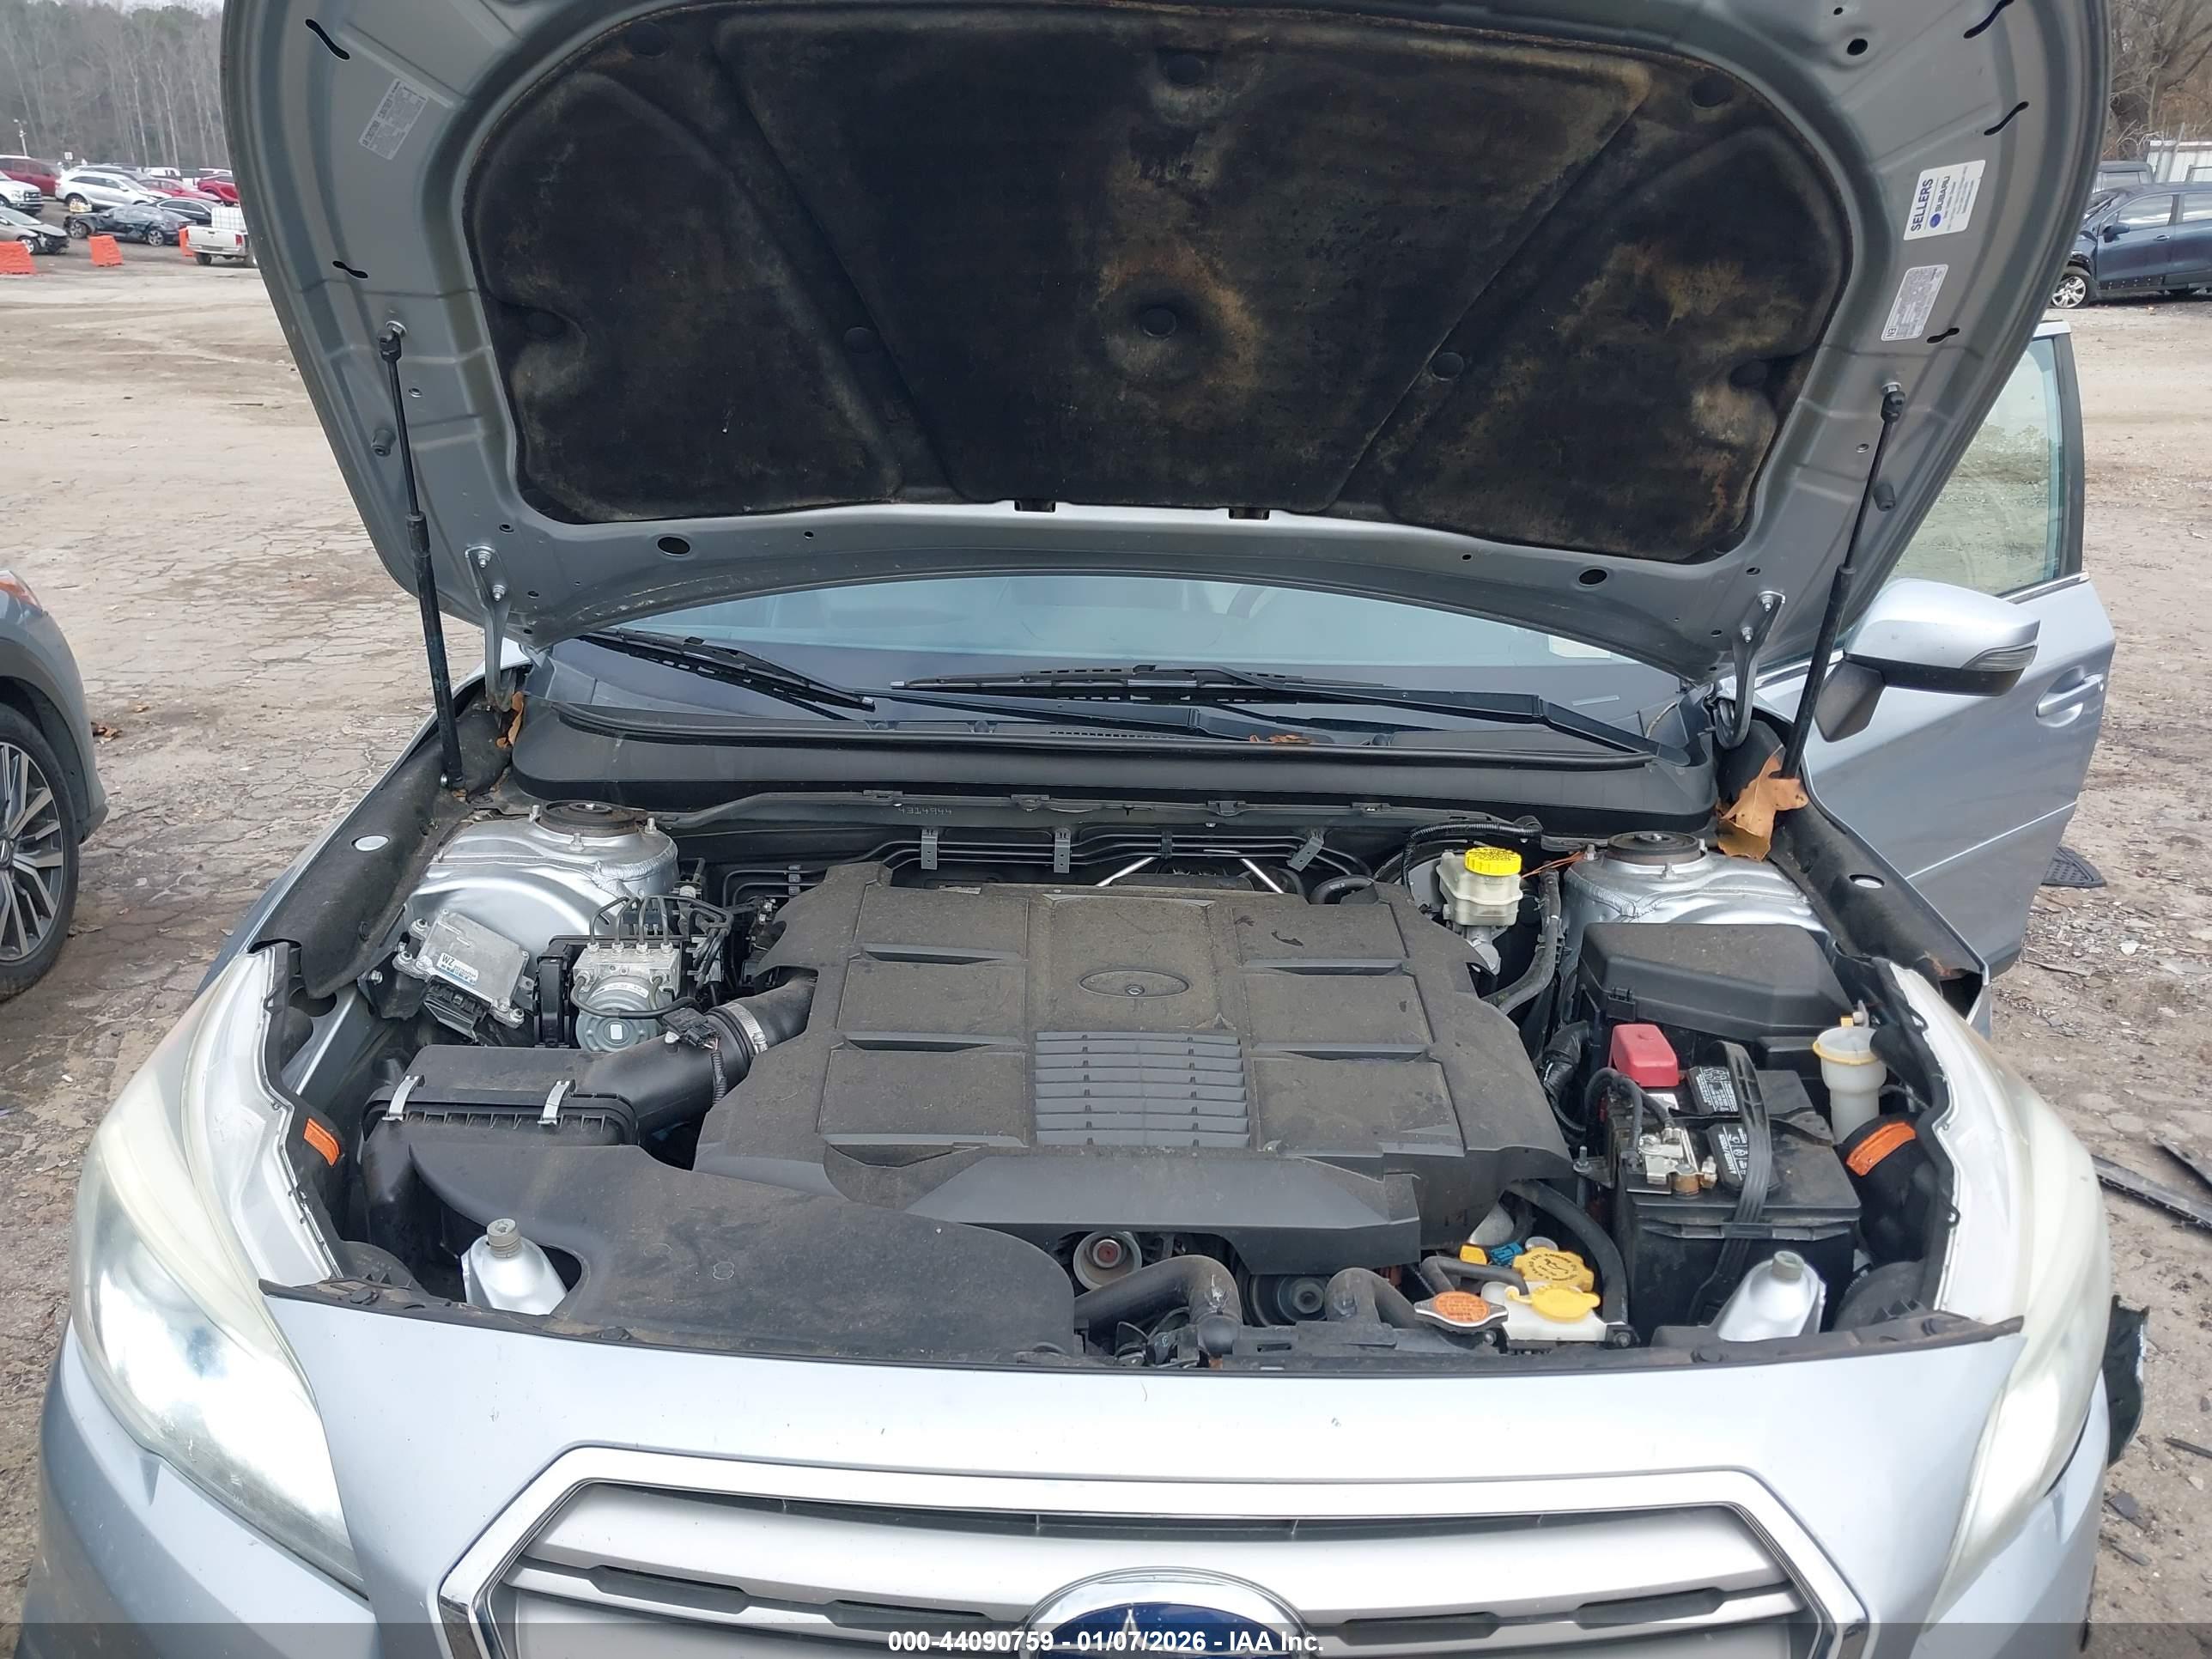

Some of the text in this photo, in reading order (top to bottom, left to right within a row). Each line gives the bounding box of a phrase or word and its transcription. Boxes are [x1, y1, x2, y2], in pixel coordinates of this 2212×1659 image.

[1911, 179, 1933, 232] SELLERS
[1936, 175, 1950, 212] SUBARU
[442, 954, 455, 966] WZ
